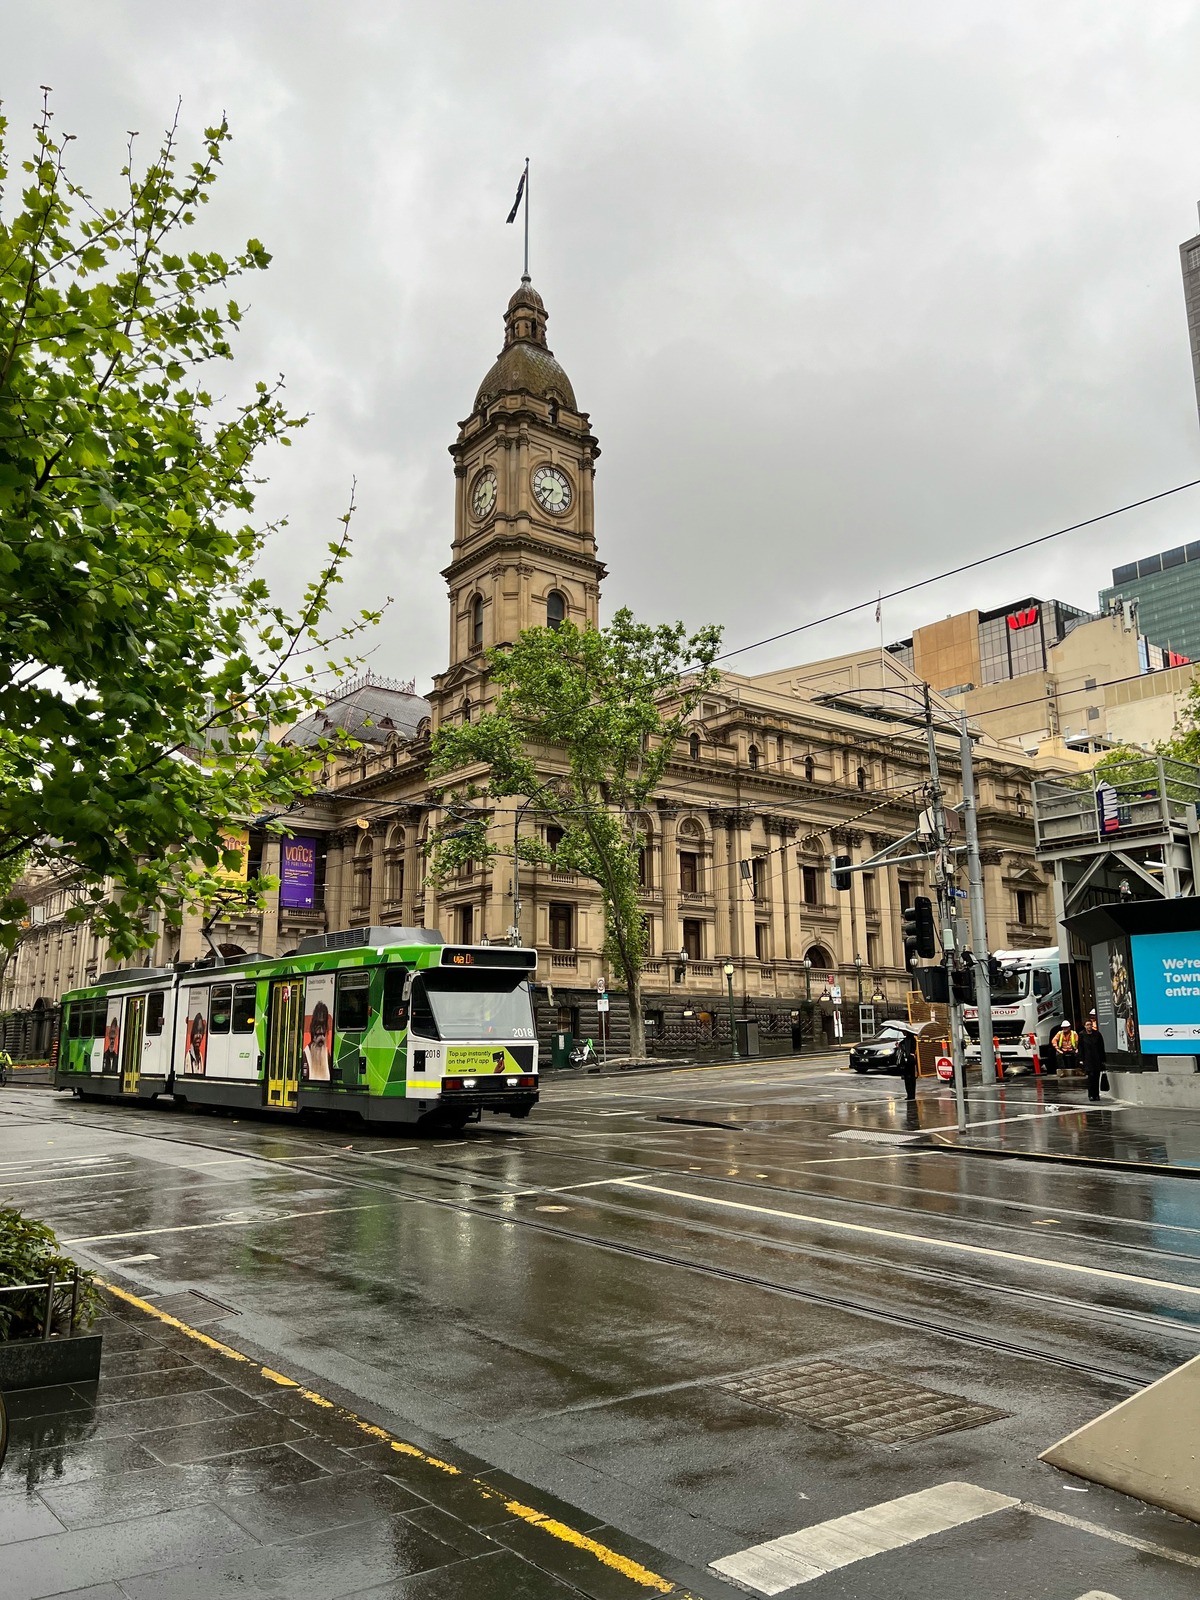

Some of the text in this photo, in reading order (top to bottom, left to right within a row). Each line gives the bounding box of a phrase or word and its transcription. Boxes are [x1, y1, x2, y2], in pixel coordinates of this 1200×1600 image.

[1162, 958, 1200, 970] We're
[1163, 972, 1200, 983] Town
[1165, 986, 1200, 997] entra
[512, 1027, 533, 1038] 2018
[425, 1049, 441, 1058] 2018
